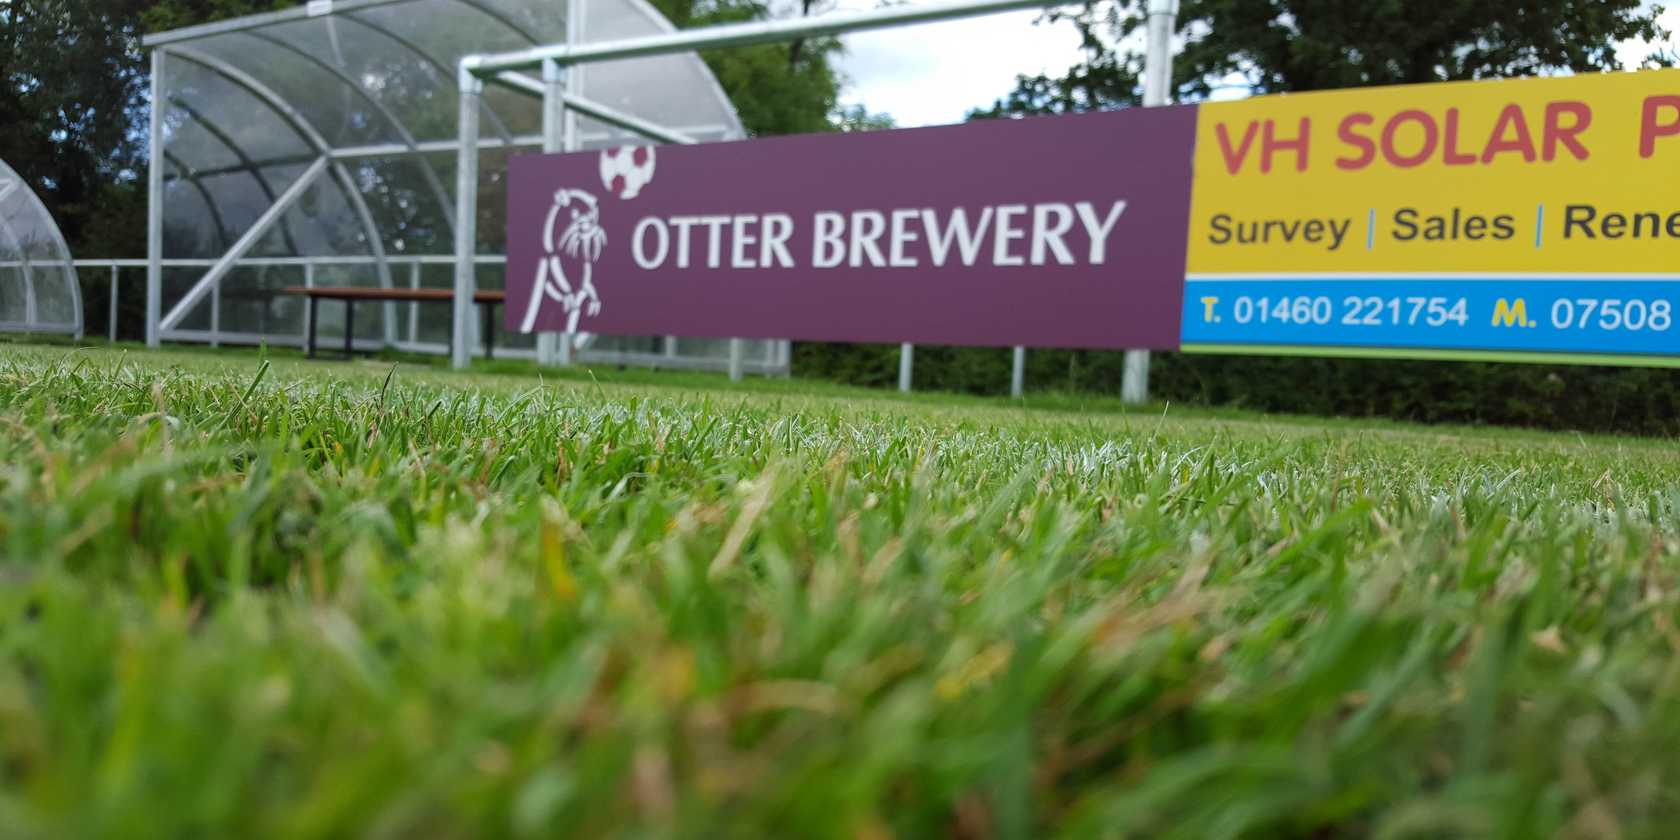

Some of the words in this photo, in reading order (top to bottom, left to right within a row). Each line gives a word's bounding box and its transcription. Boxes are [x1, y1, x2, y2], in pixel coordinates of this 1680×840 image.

[1215, 117, 1311, 175] VH
[1335, 100, 1593, 171] SOLAR
[631, 213, 794, 269] OTTER
[811, 200, 1127, 267] BREWERY
[1208, 214, 1350, 250] Survey
[1391, 208, 1516, 241] Sales
[1202, 297, 1222, 323] T.
[1234, 296, 1332, 325] 01460
[1342, 297, 1469, 327] 221754
[1491, 299, 1537, 328] M.
[1551, 300, 1671, 330] 07508
